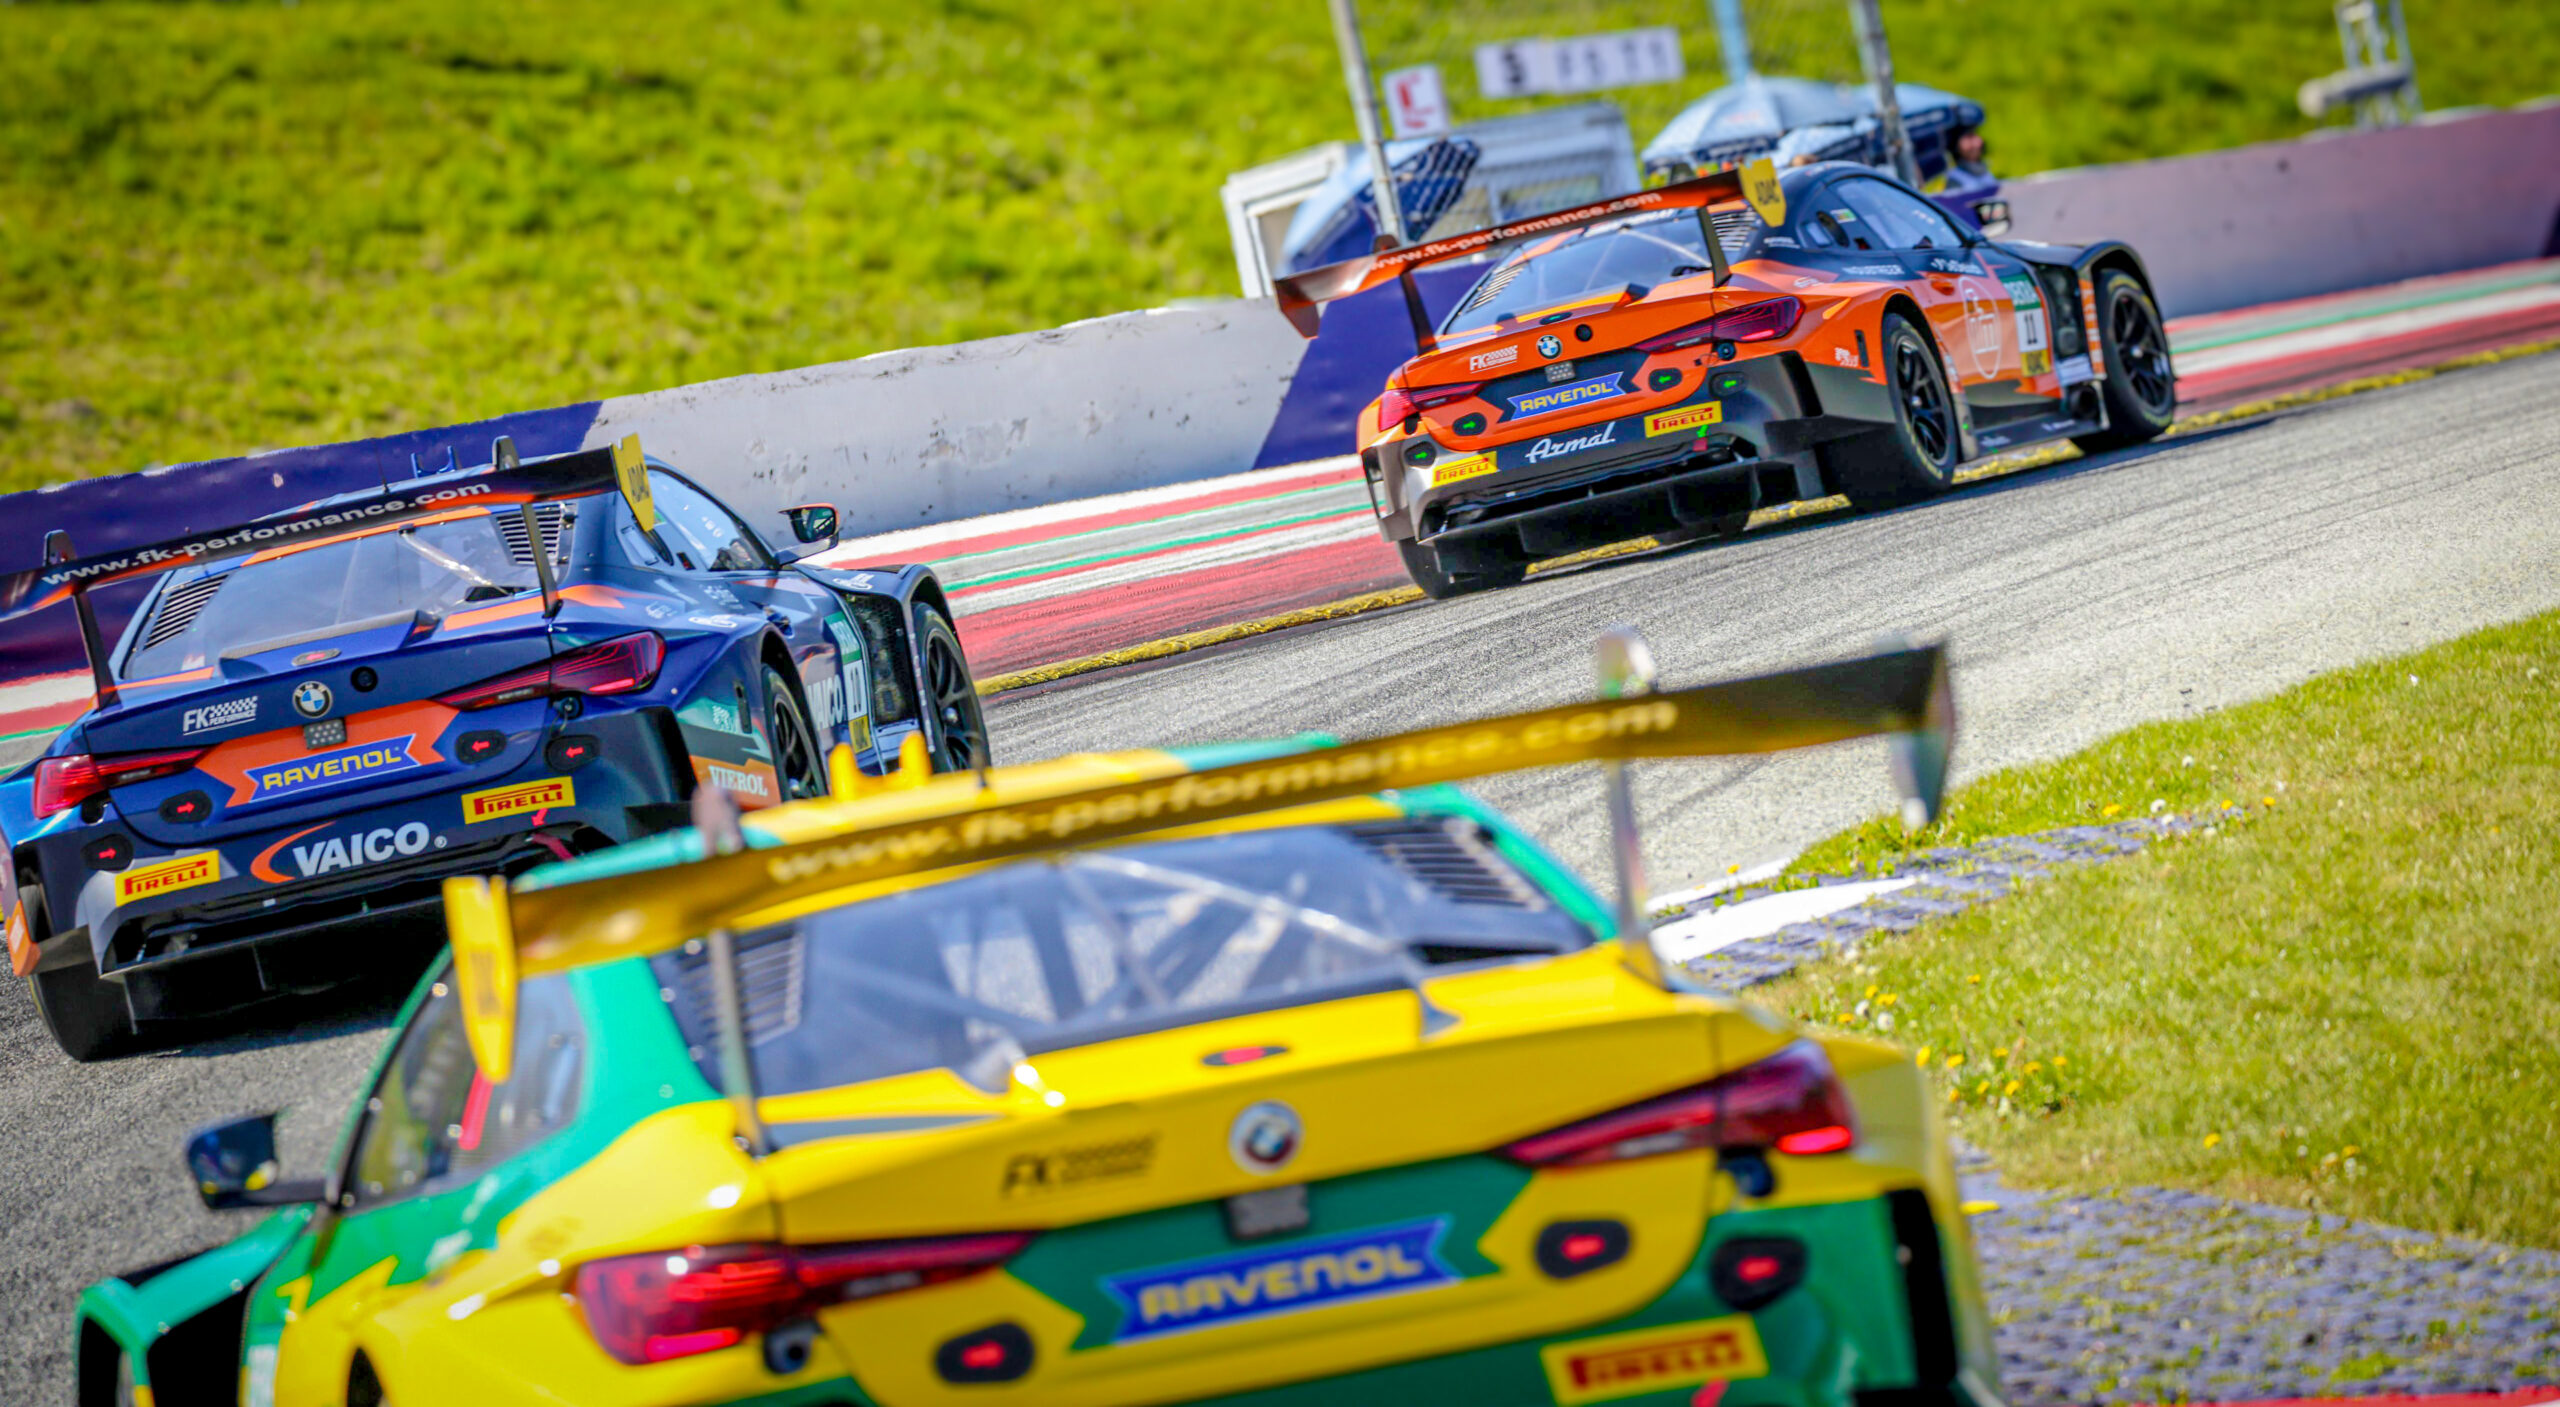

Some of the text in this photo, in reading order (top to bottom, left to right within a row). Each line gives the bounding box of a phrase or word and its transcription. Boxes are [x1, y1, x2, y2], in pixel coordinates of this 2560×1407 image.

[1369, 191, 1662, 271] www.fk-performance.com
[1520, 382, 1615, 412] RAVENOL
[1653, 406, 1713, 431] PIRELLI
[1524, 421, 1616, 463] Armal
[1434, 457, 1489, 482] PIRELLI
[41, 483, 491, 585] www.fk-performance.com
[182, 706, 211, 732] FK
[262, 748, 402, 790] RAVENOL
[708, 765, 768, 797] VIEROL
[474, 783, 563, 815] PIRELLI
[124, 859, 207, 895] PIRELLI
[1138, 1243, 1426, 1324] RAVENOL
